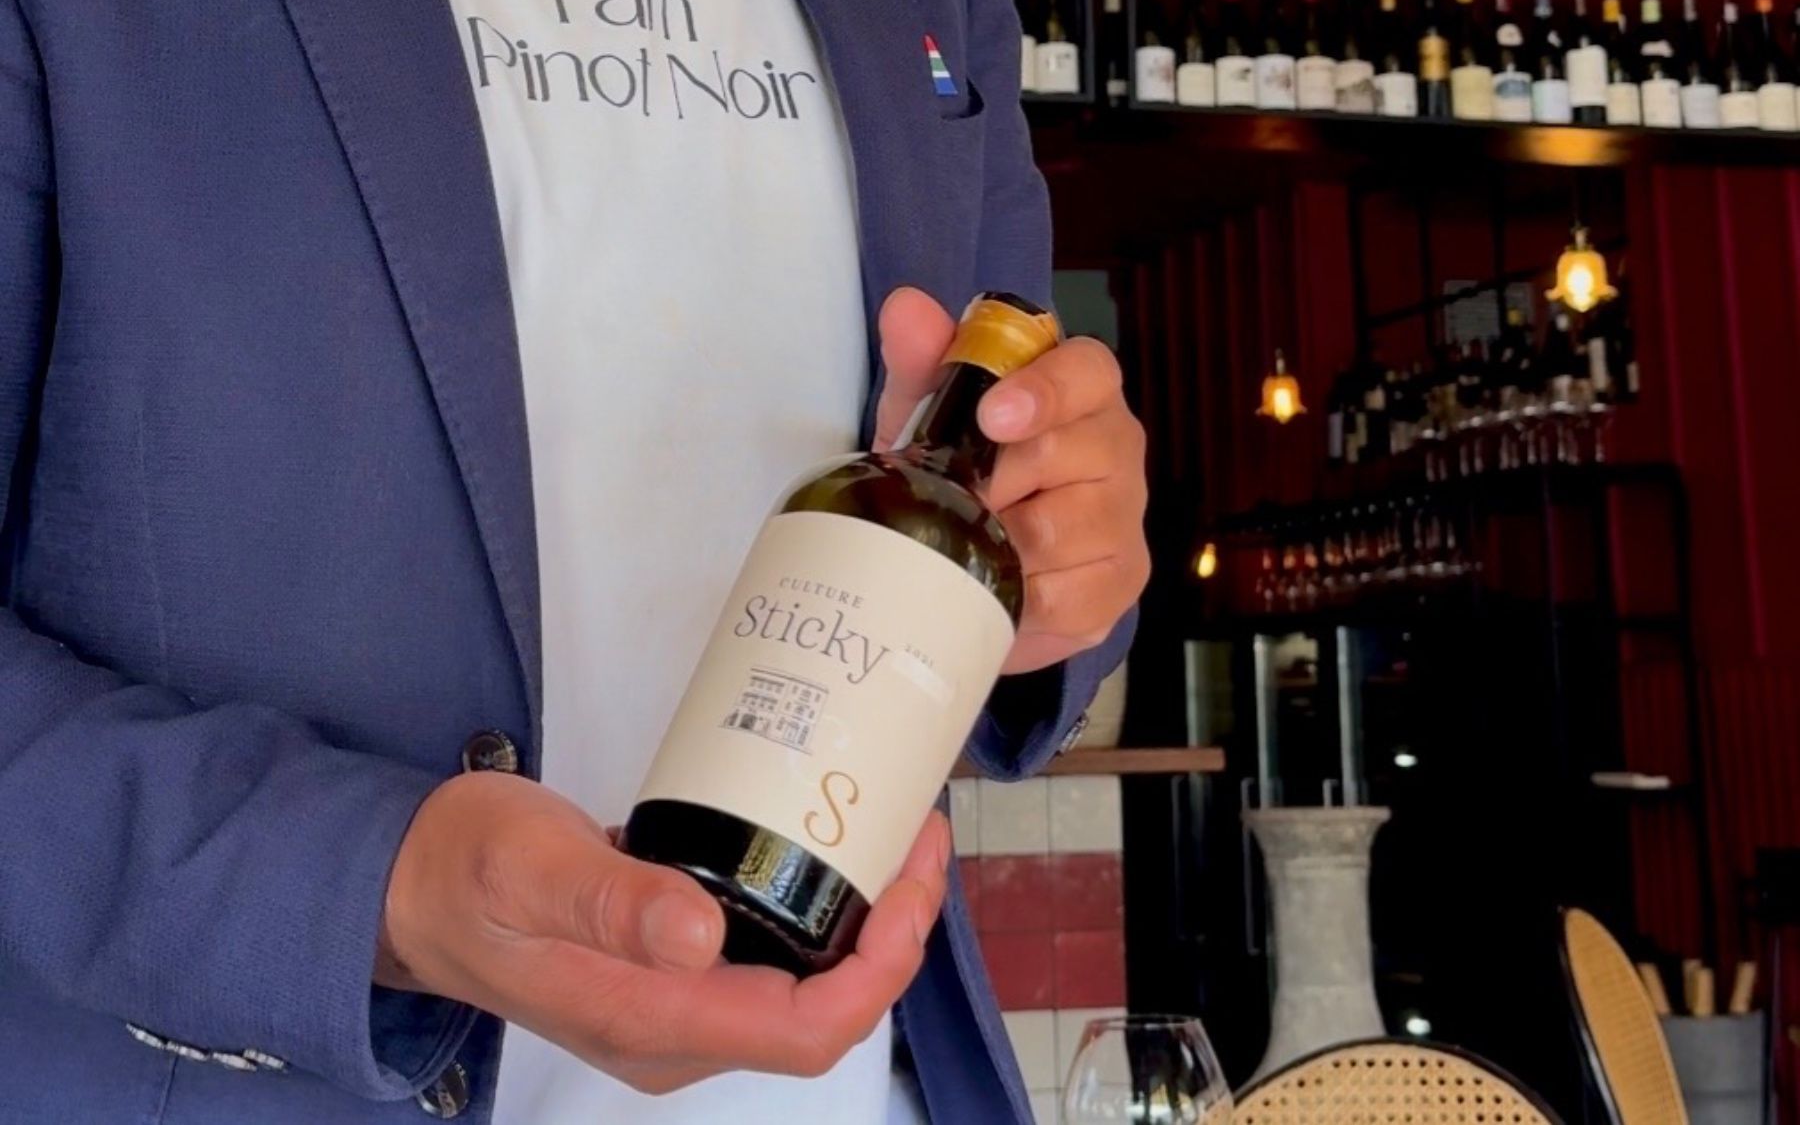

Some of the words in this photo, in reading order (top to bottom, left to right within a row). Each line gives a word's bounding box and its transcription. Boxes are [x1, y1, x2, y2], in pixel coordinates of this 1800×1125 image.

[467, 17, 651, 116] Pinot
[666, 49, 816, 119] Noir
[779, 576, 865, 609] CULTURE
[803, 771, 859, 847] S
